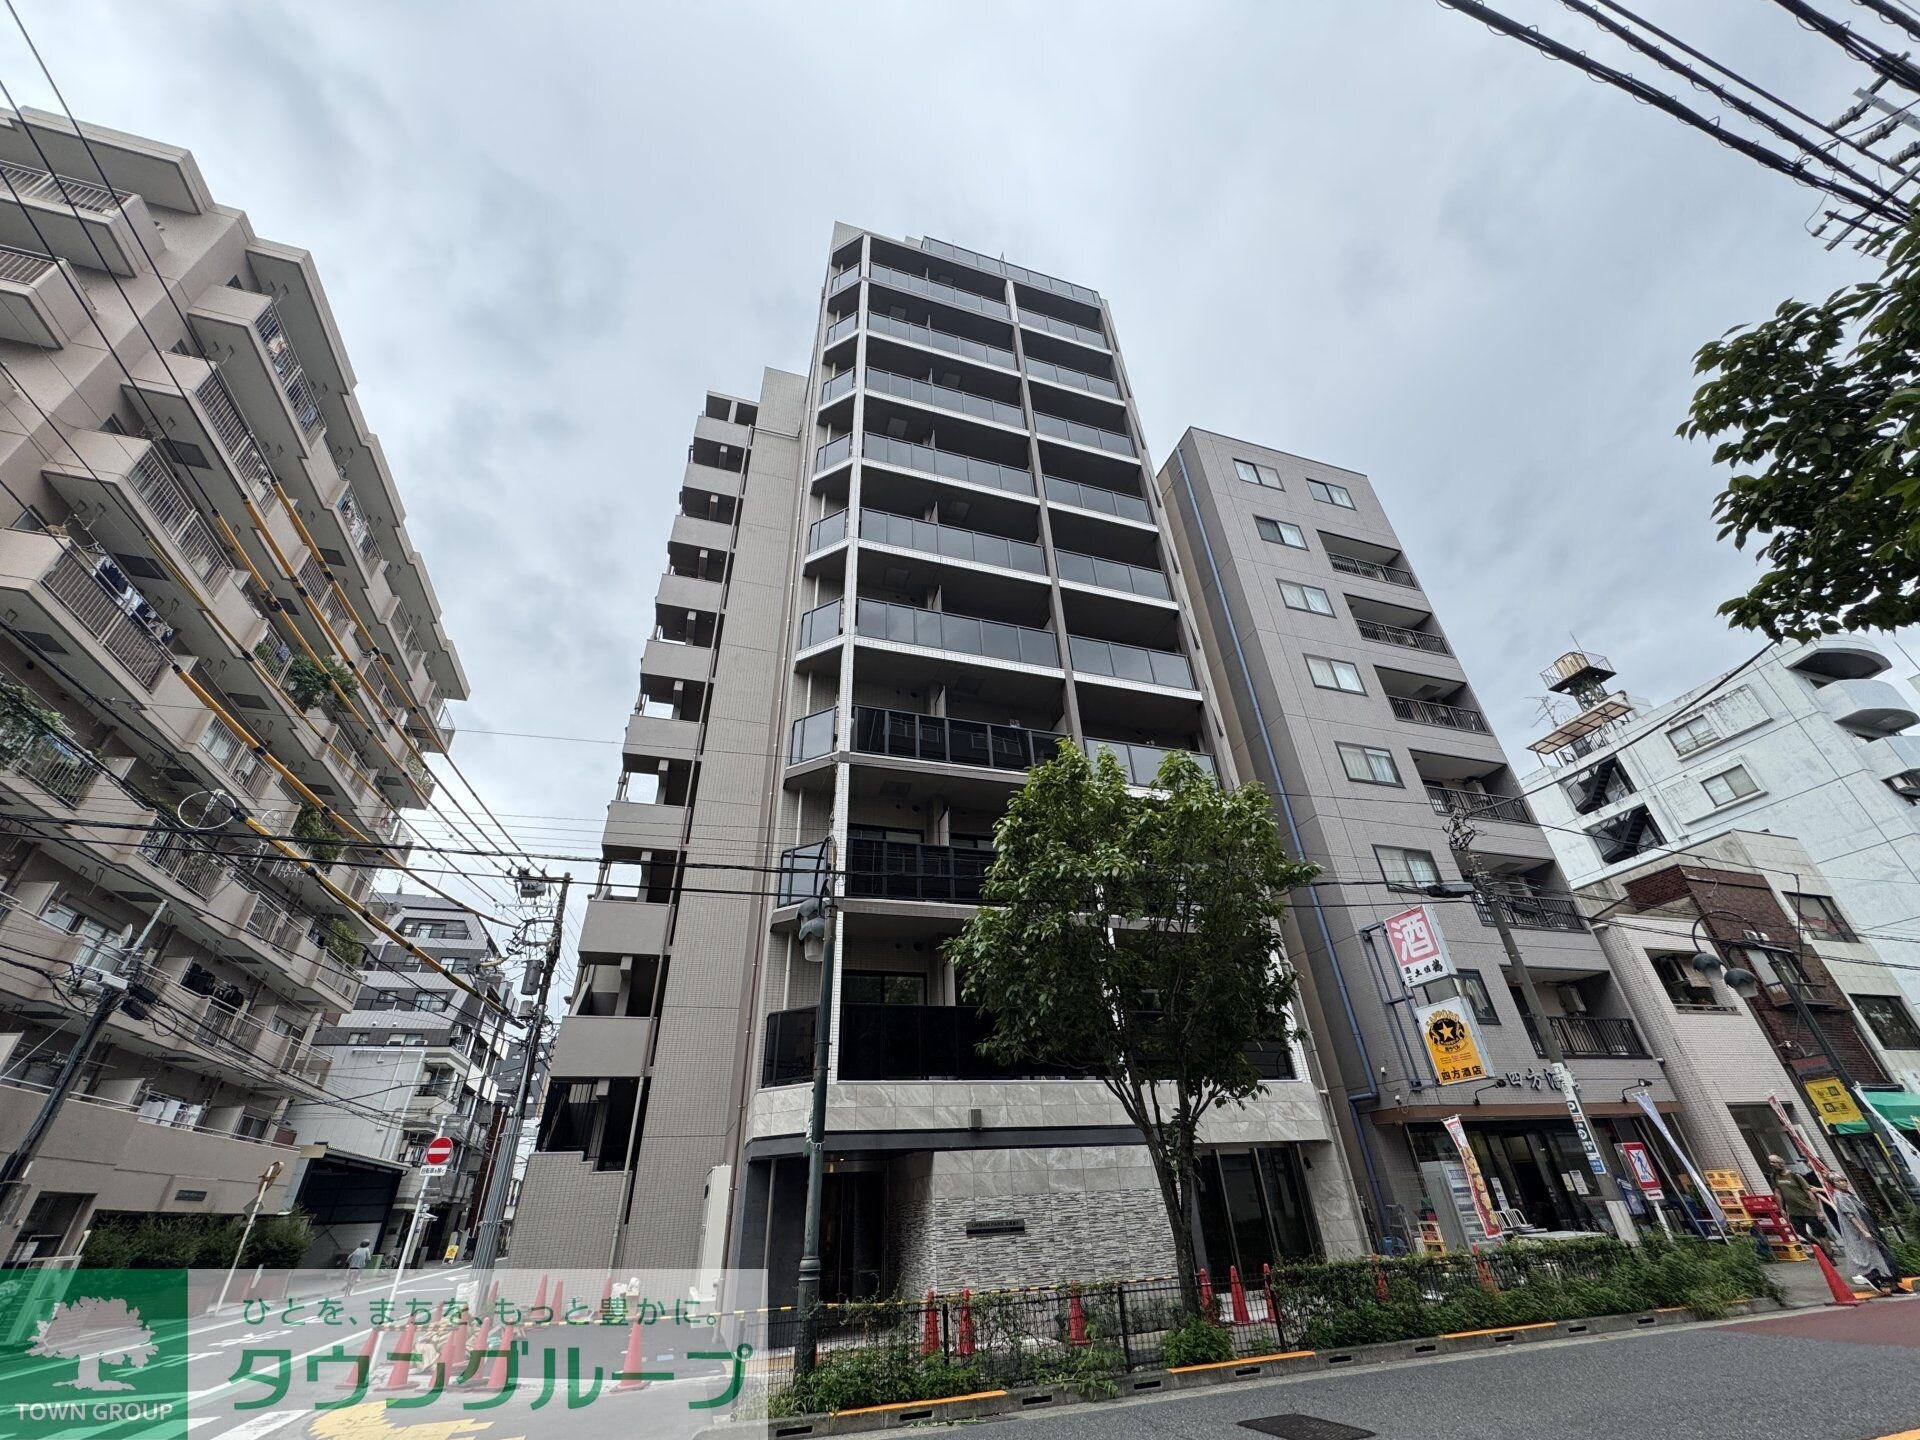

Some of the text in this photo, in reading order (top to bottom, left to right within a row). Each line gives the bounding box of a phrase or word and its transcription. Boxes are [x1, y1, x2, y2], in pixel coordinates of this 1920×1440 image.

[1391, 912, 1434, 961] 酒
[1441, 1065, 1482, 1080] 四方酒店
